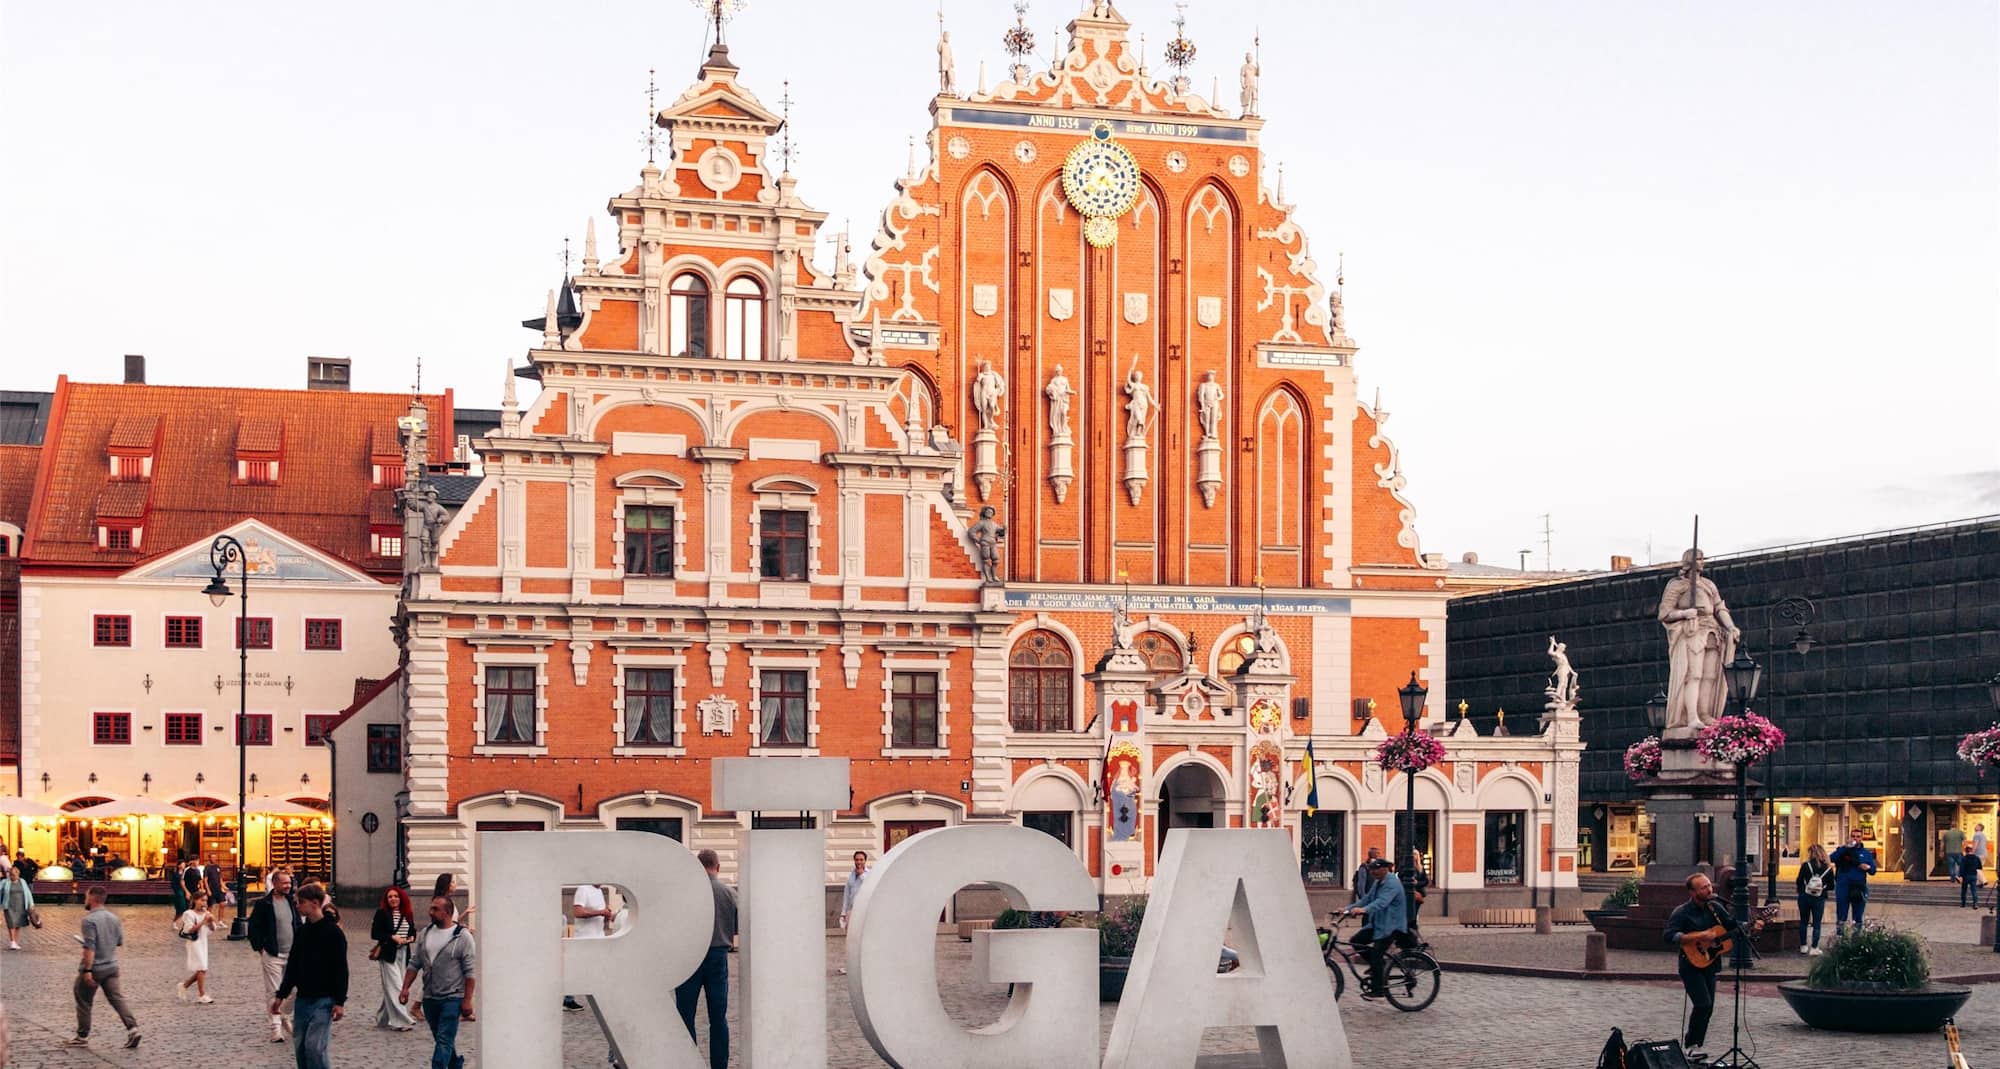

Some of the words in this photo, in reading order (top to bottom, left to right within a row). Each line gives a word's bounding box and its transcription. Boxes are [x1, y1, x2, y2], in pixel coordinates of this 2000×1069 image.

[1028, 115, 1055, 127] ANNO
[1058, 117, 1079, 128] 1334
[1149, 123, 1175, 135] ANNO
[1178, 125, 1198, 136] 1999
